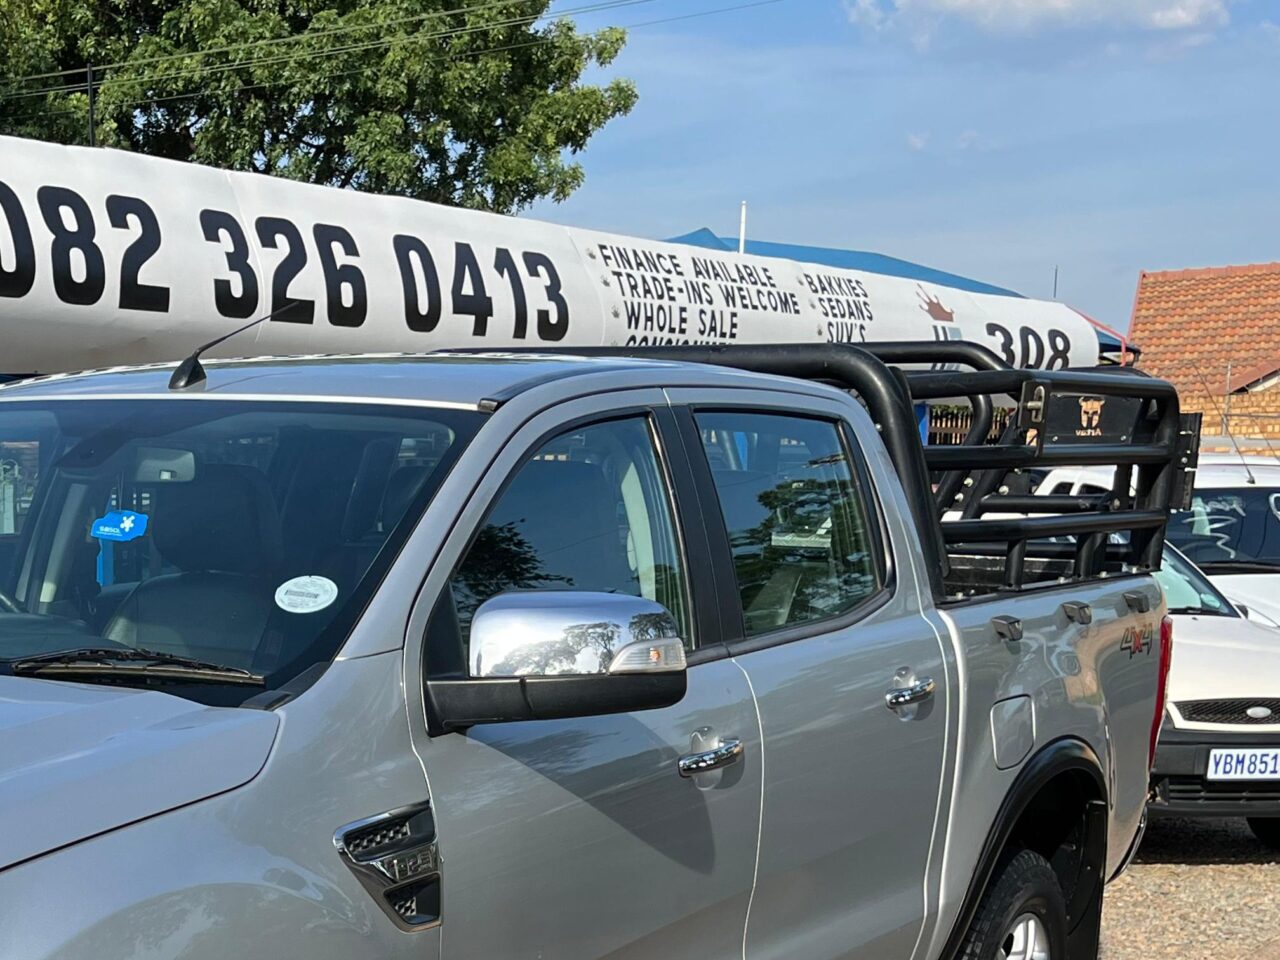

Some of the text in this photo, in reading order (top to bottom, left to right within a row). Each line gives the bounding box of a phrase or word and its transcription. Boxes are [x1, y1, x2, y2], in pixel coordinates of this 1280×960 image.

[200, 208, 368, 328] 326
[393, 233, 570, 342] 0413
[598, 244, 777, 288] FINANCE AVAILABLE
[612, 271, 802, 315] TRADE-INS WELCOME
[803, 273, 868, 298] BAKKIES
[624, 301, 739, 339] WHOLE SALE
[818, 296, 874, 322] SEDANS
[827, 321, 867, 343] SUV'S
[986, 322, 1071, 371] 308
[1213, 753, 1279, 775] YBM851
